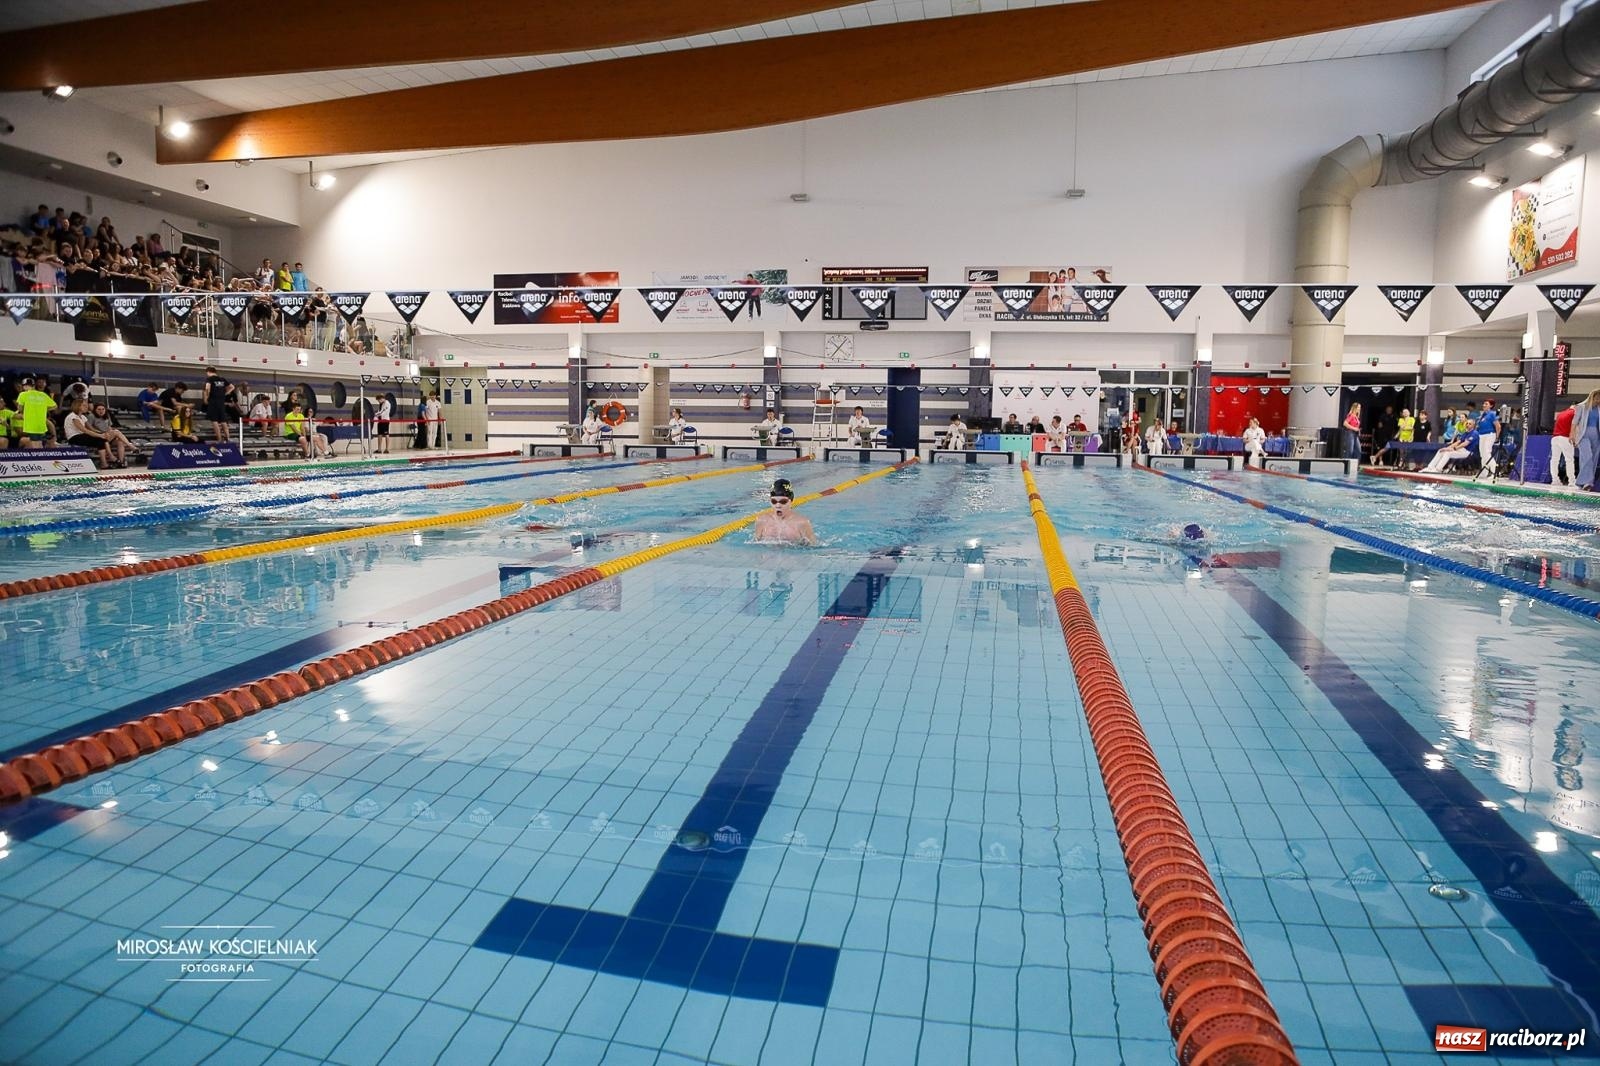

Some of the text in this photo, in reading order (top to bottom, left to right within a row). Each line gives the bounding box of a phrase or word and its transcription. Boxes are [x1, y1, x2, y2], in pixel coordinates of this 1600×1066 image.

[520, 293, 548, 303] arena
[584, 292, 612, 302] arena
[648, 291, 676, 301] arena
[717, 290, 746, 300] arena
[787, 289, 816, 300] arena
[859, 289, 888, 299] arena
[930, 289, 960, 299] arena
[1002, 289, 1034, 299] arena
[1084, 289, 1115, 299] arena
[1158, 289, 1190, 299] arena
[1234, 289, 1265, 299] arena
[1313, 289, 1345, 299] arena
[1391, 289, 1421, 299] arena
[1469, 289, 1499, 299] arena
[1549, 288, 1581, 299] arena
[61, 298, 84, 307] arena
[113, 298, 138, 307] arena
[167, 298, 192, 307] arena
[222, 297, 246, 306] arena
[279, 296, 304, 306] arena
[337, 296, 362, 305] arena
[395, 295, 421, 304] arena
[458, 295, 484, 304] arena
